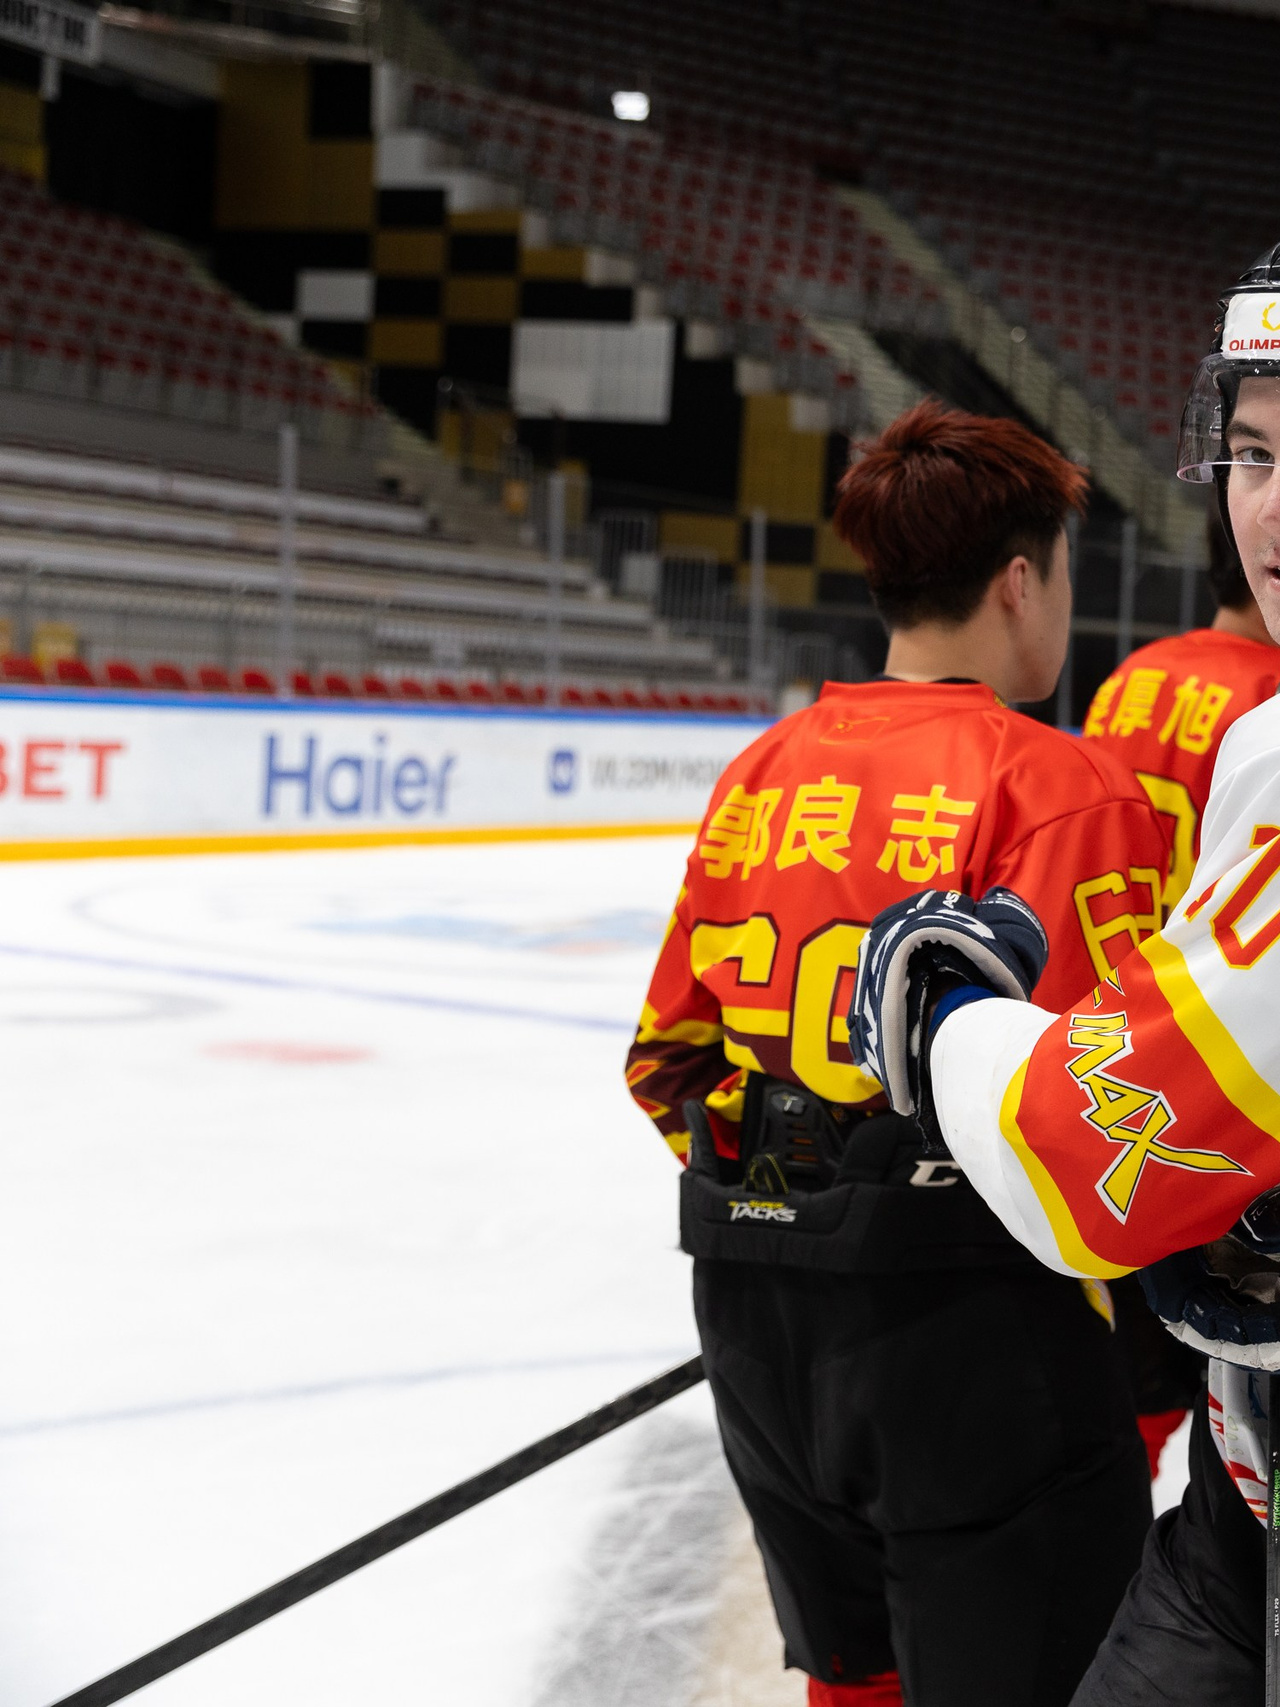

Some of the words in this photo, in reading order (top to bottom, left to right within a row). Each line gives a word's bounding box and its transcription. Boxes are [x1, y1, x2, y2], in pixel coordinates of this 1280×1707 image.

[0, 739, 127, 800] ET
[261, 731, 458, 817] Haier
[699, 775, 977, 883] 郭良志
[729, 1202, 798, 1222] TACKS
